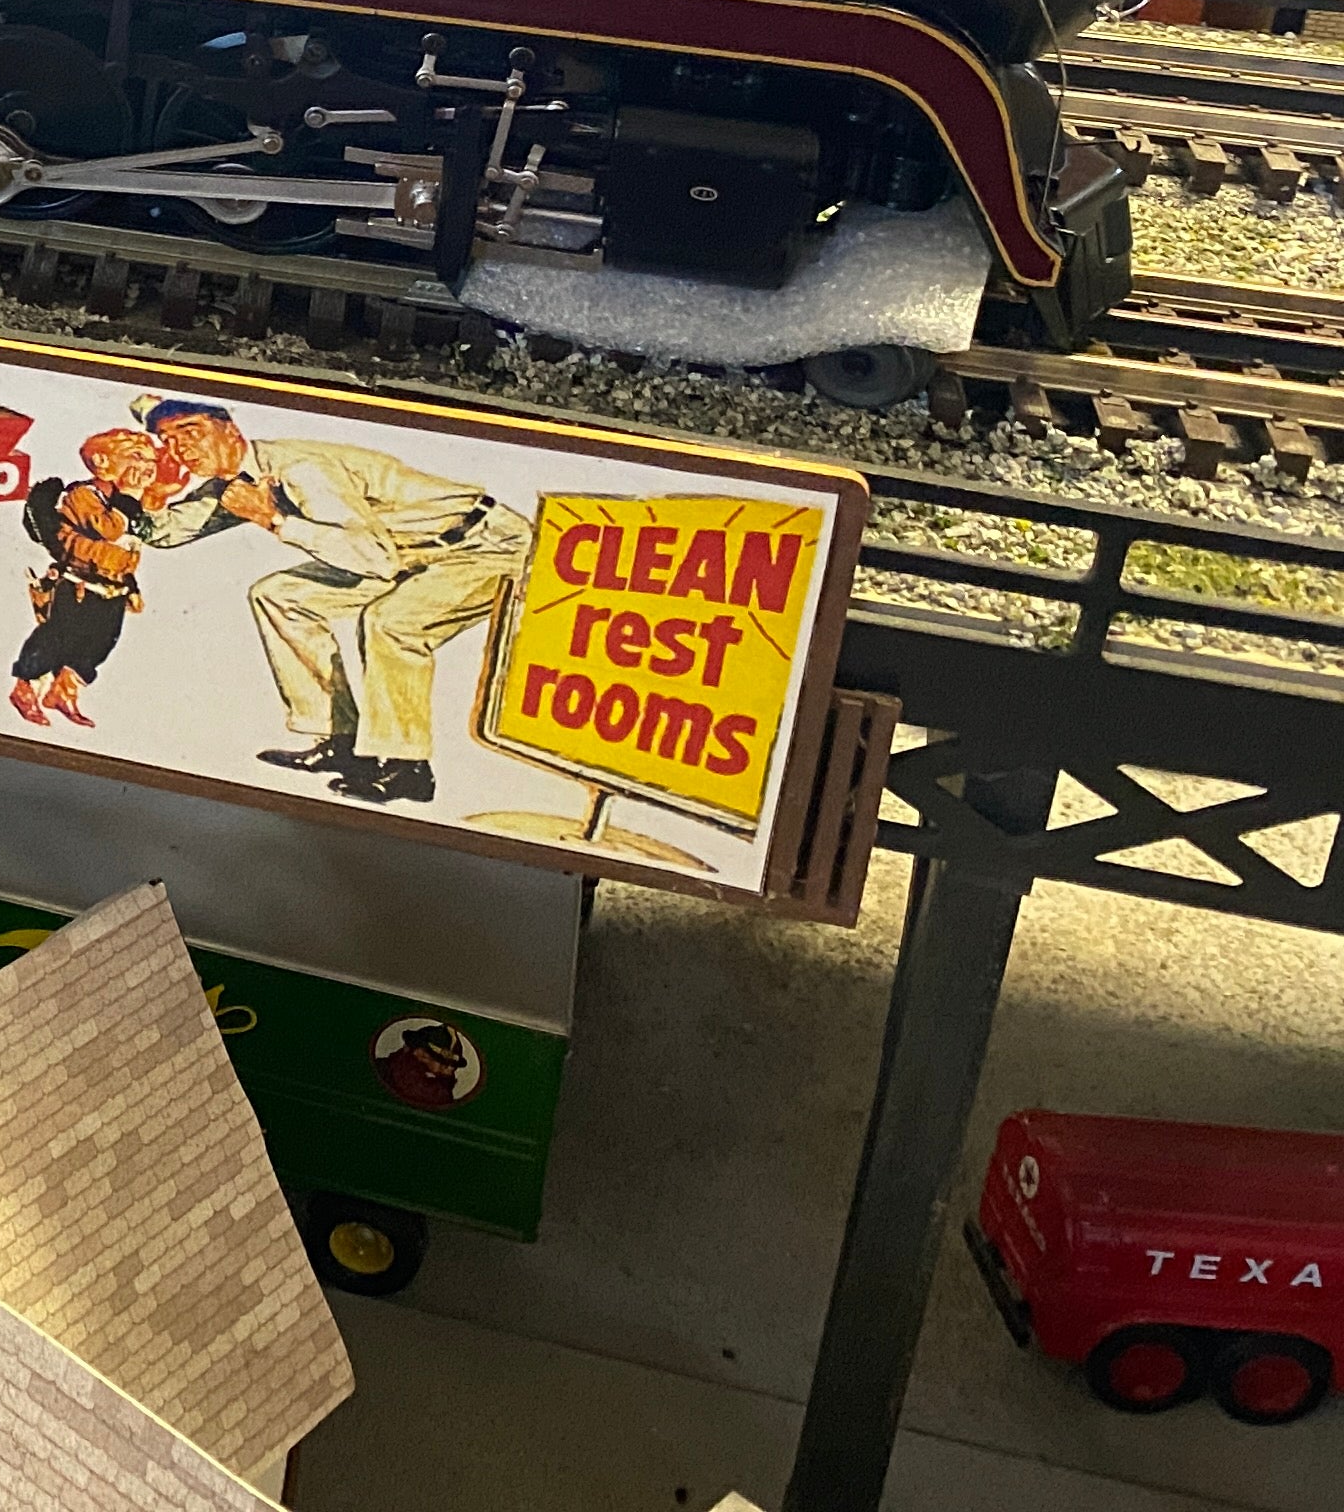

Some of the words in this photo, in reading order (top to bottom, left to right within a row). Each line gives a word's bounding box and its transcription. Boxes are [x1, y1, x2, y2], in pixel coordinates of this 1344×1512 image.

[552, 522, 803, 614] CLEAN
[568, 603, 744, 687] rest
[520, 663, 758, 778] rooms
